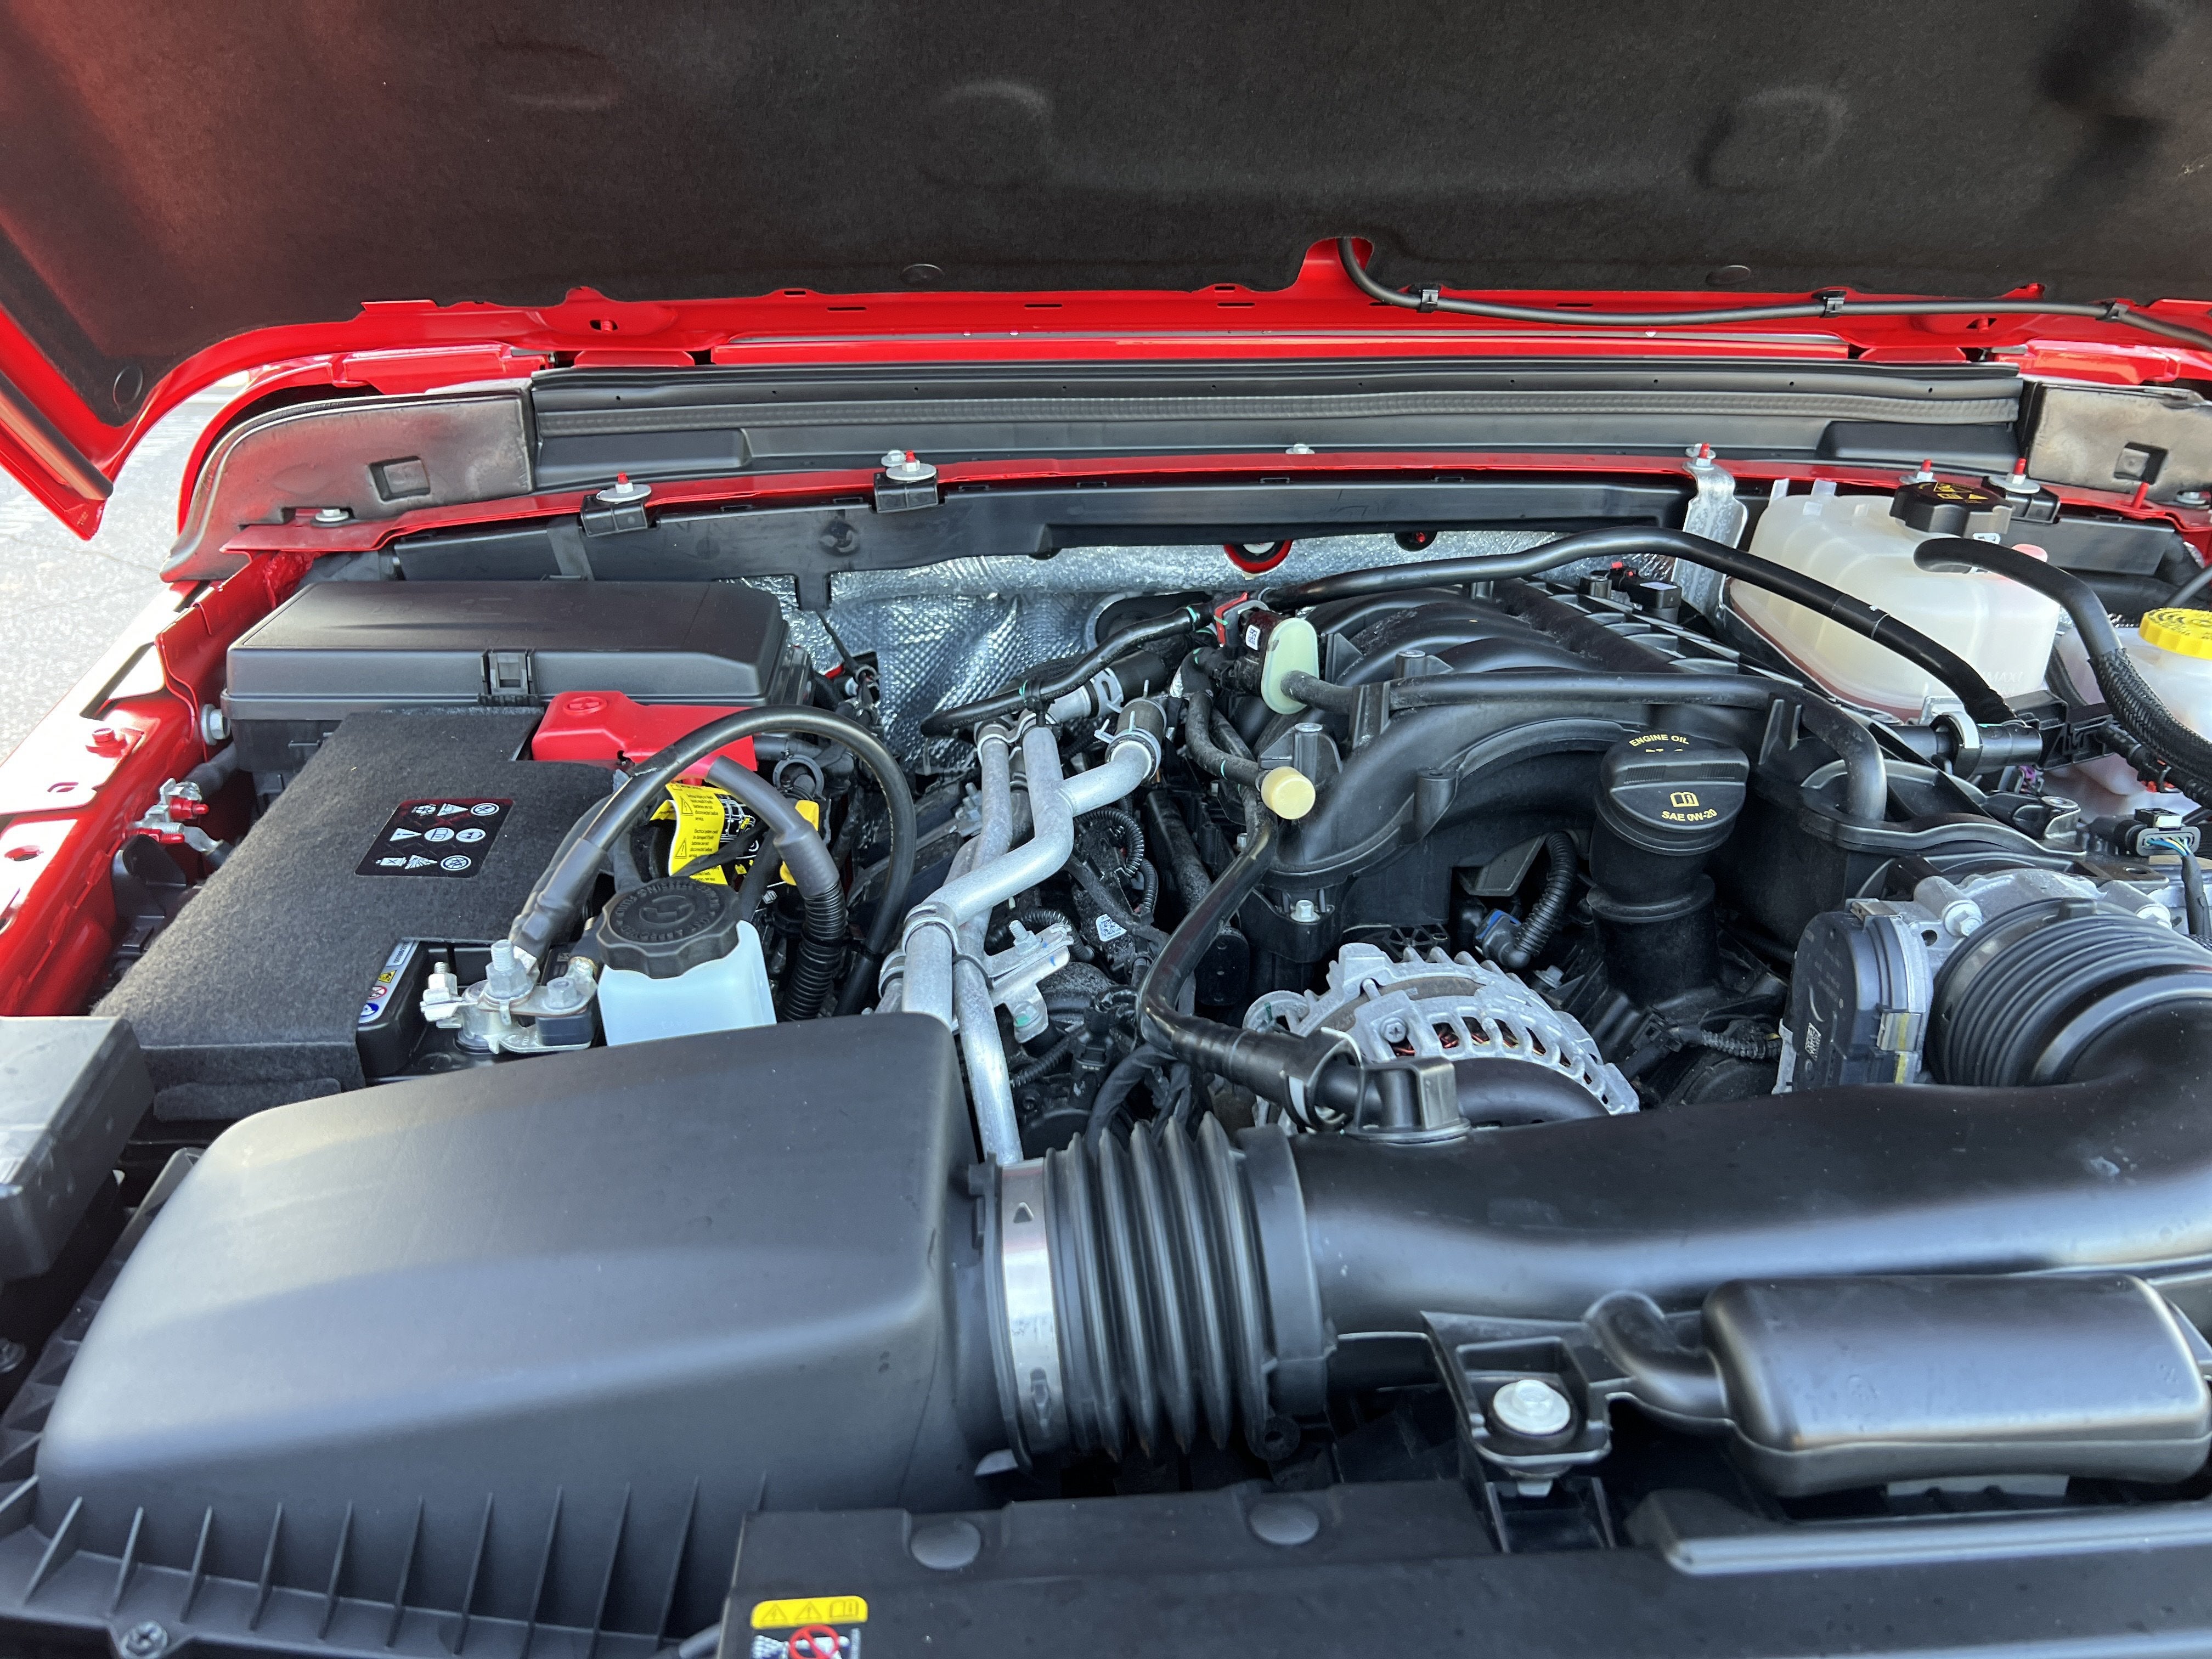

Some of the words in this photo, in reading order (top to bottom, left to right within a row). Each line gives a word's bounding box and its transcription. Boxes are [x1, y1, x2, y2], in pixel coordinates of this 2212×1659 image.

[1629, 734, 1669, 747] ENGINE
[1671, 735, 1690, 745] OIL
[1661, 810, 1685, 822] SAE
[1686, 809, 1718, 822] 0W-20
